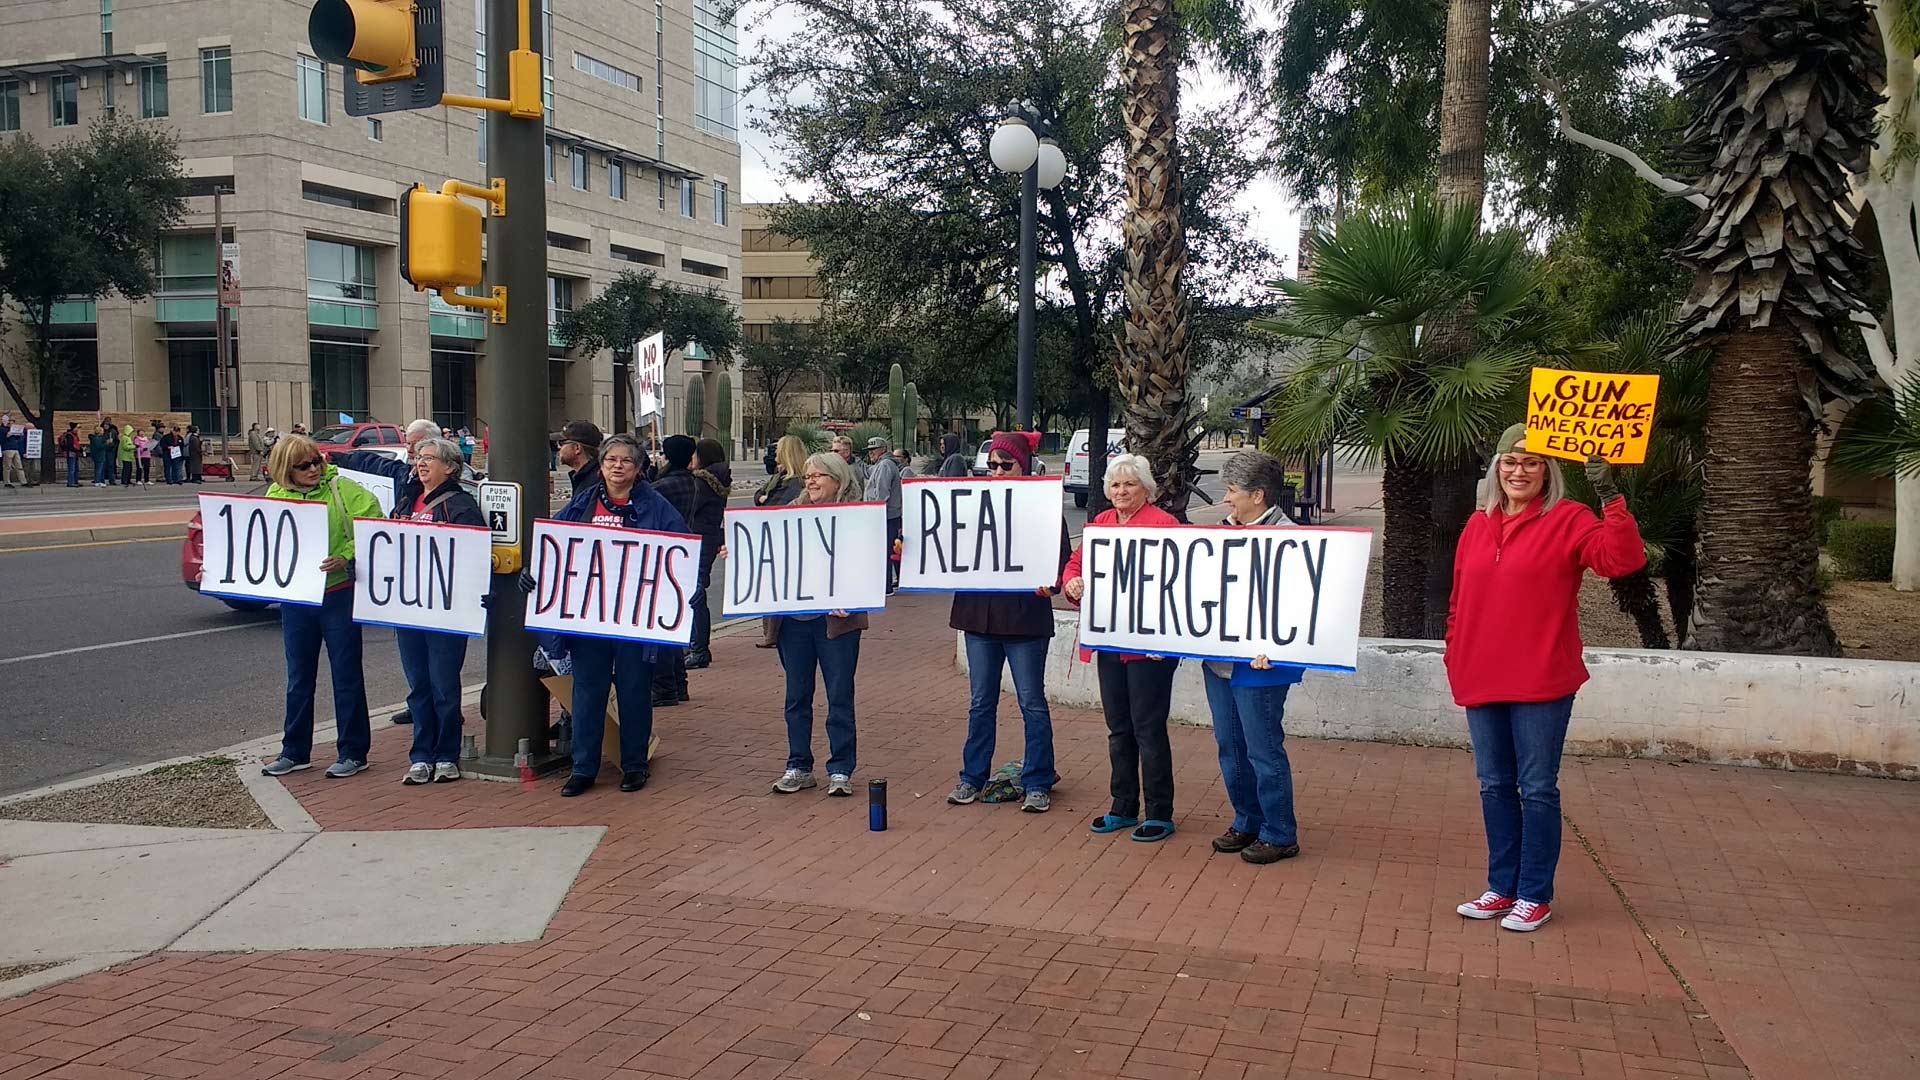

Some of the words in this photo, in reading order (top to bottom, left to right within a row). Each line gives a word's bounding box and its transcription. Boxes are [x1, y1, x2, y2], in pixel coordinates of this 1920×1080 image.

[643, 343, 657, 369] NO
[1555, 375, 1631, 403] GUN
[1528, 415, 1643, 439] AMERICA'S
[1546, 435, 1625, 458] EBOLA
[489, 487, 508, 495] PUSH
[218, 503, 299, 588] 100
[368, 530, 455, 610] GUN
[733, 516, 836, 606] DAILY
[919, 488, 1024, 575] REAL
[535, 533, 689, 632] DEATHS
[1089, 537, 1328, 646] EMERGENCY
